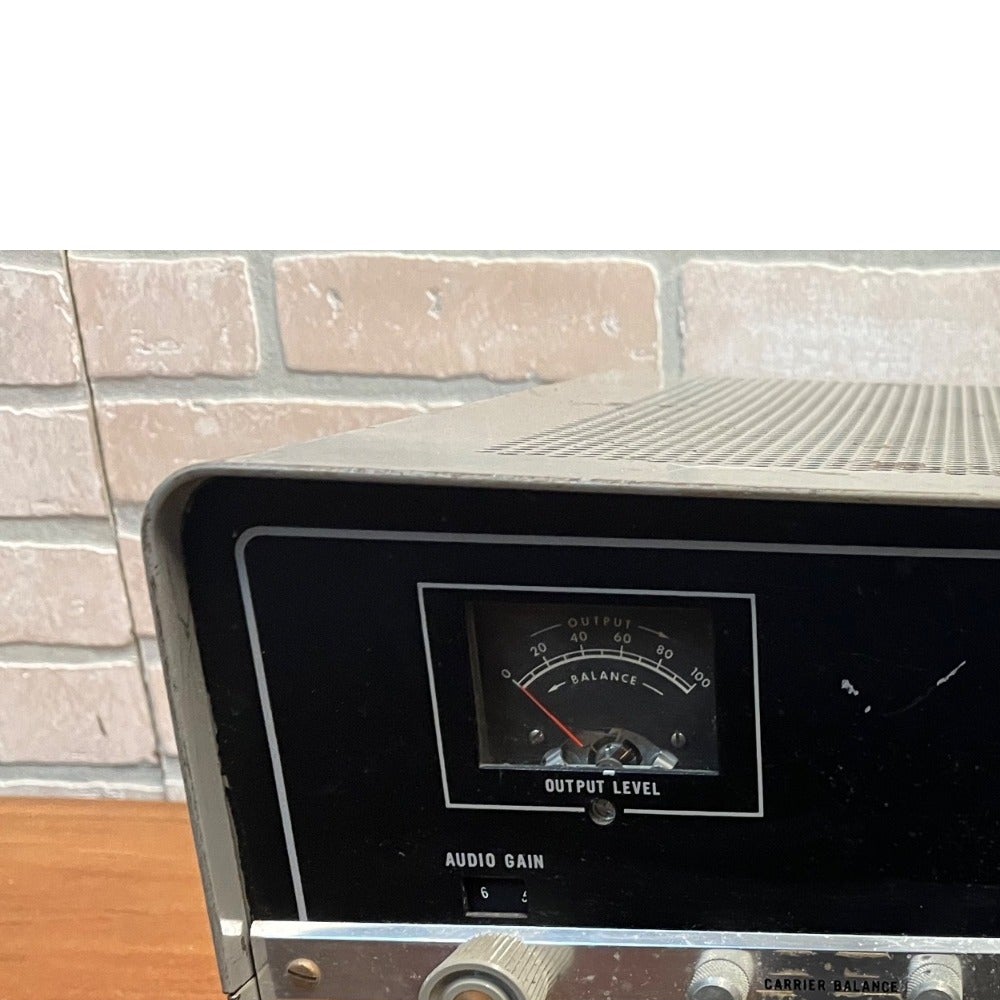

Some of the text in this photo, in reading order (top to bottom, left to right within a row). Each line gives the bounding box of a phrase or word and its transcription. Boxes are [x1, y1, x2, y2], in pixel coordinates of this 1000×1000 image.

[568, 616, 631, 629] OUTPUT
[570, 631, 588, 643] 40
[613, 633, 632, 644] 60
[530, 642, 547, 657] 20
[656, 644, 674, 660] 80
[501, 669, 512, 679] 0
[570, 671, 638, 686] BALANCE
[690, 667, 711, 688] 100
[545, 779, 661, 796] OUTPUT LEVEL
[445, 852, 544, 869] AUDIO GAIN
[480, 886, 489, 899] 6
[764, 978, 898, 993] CARRIER BALANCE
